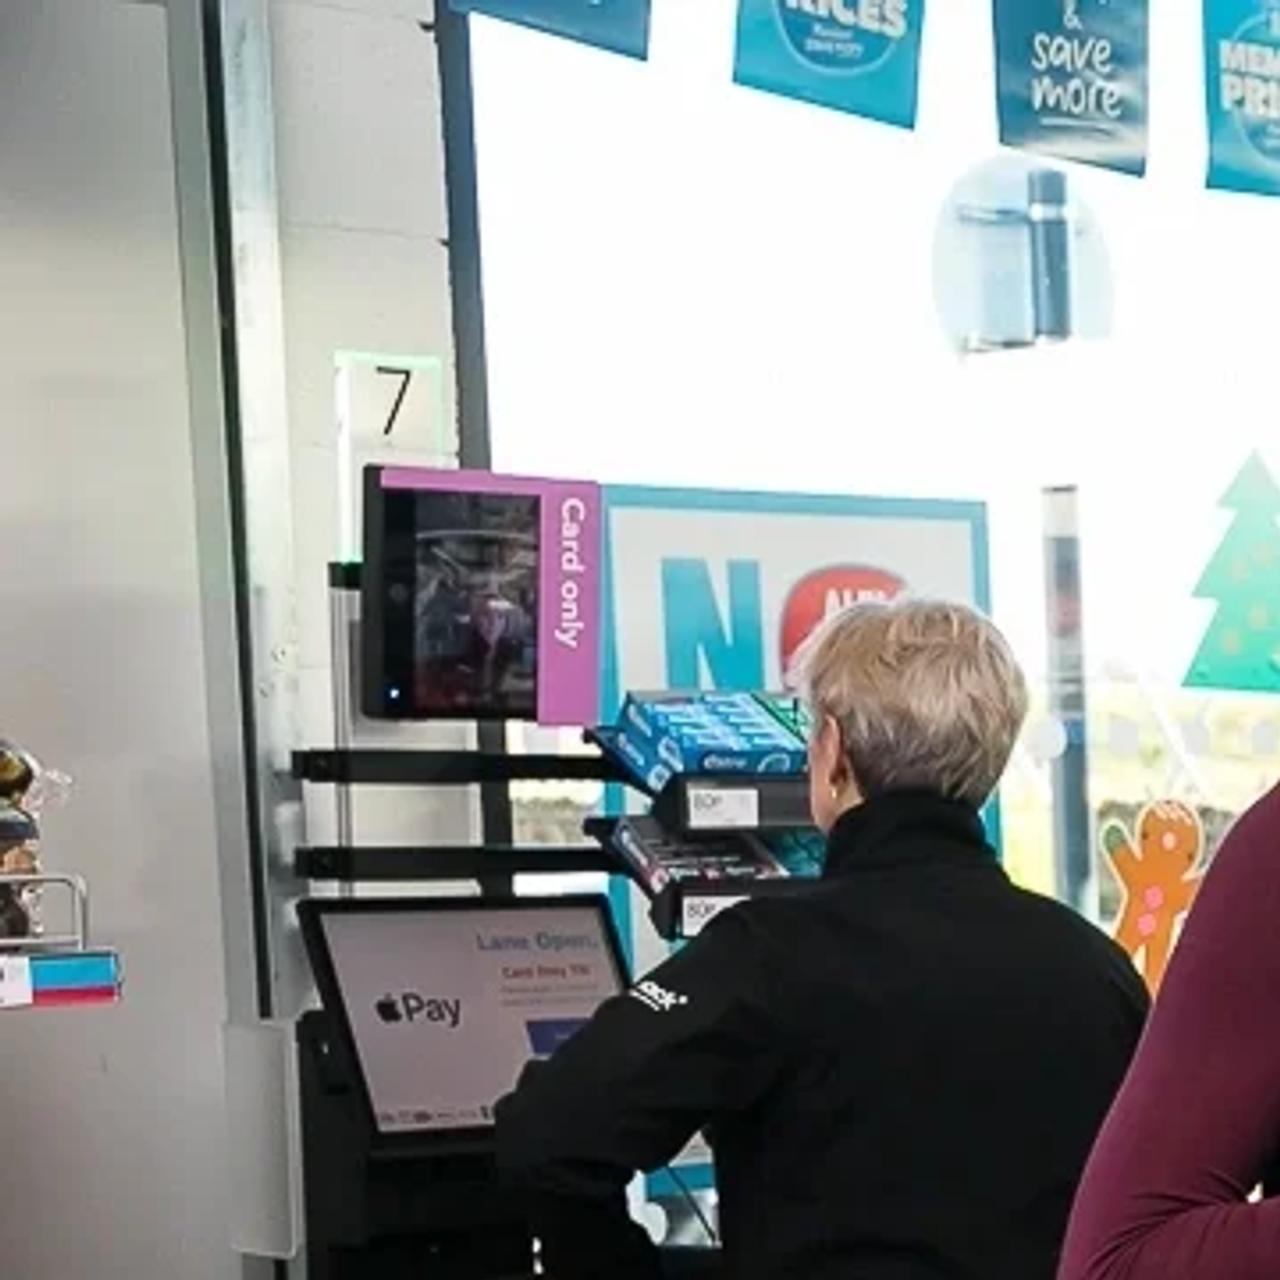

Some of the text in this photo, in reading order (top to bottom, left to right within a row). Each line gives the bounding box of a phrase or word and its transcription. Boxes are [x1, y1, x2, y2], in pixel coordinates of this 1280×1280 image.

[1032, 32, 1111, 74] save
[1032, 77, 1121, 117] more
[375, 365, 411, 436] 7
[559, 498, 585, 649] Card only
[477, 934, 529, 950] Lane
[402, 992, 460, 1028] Pay
